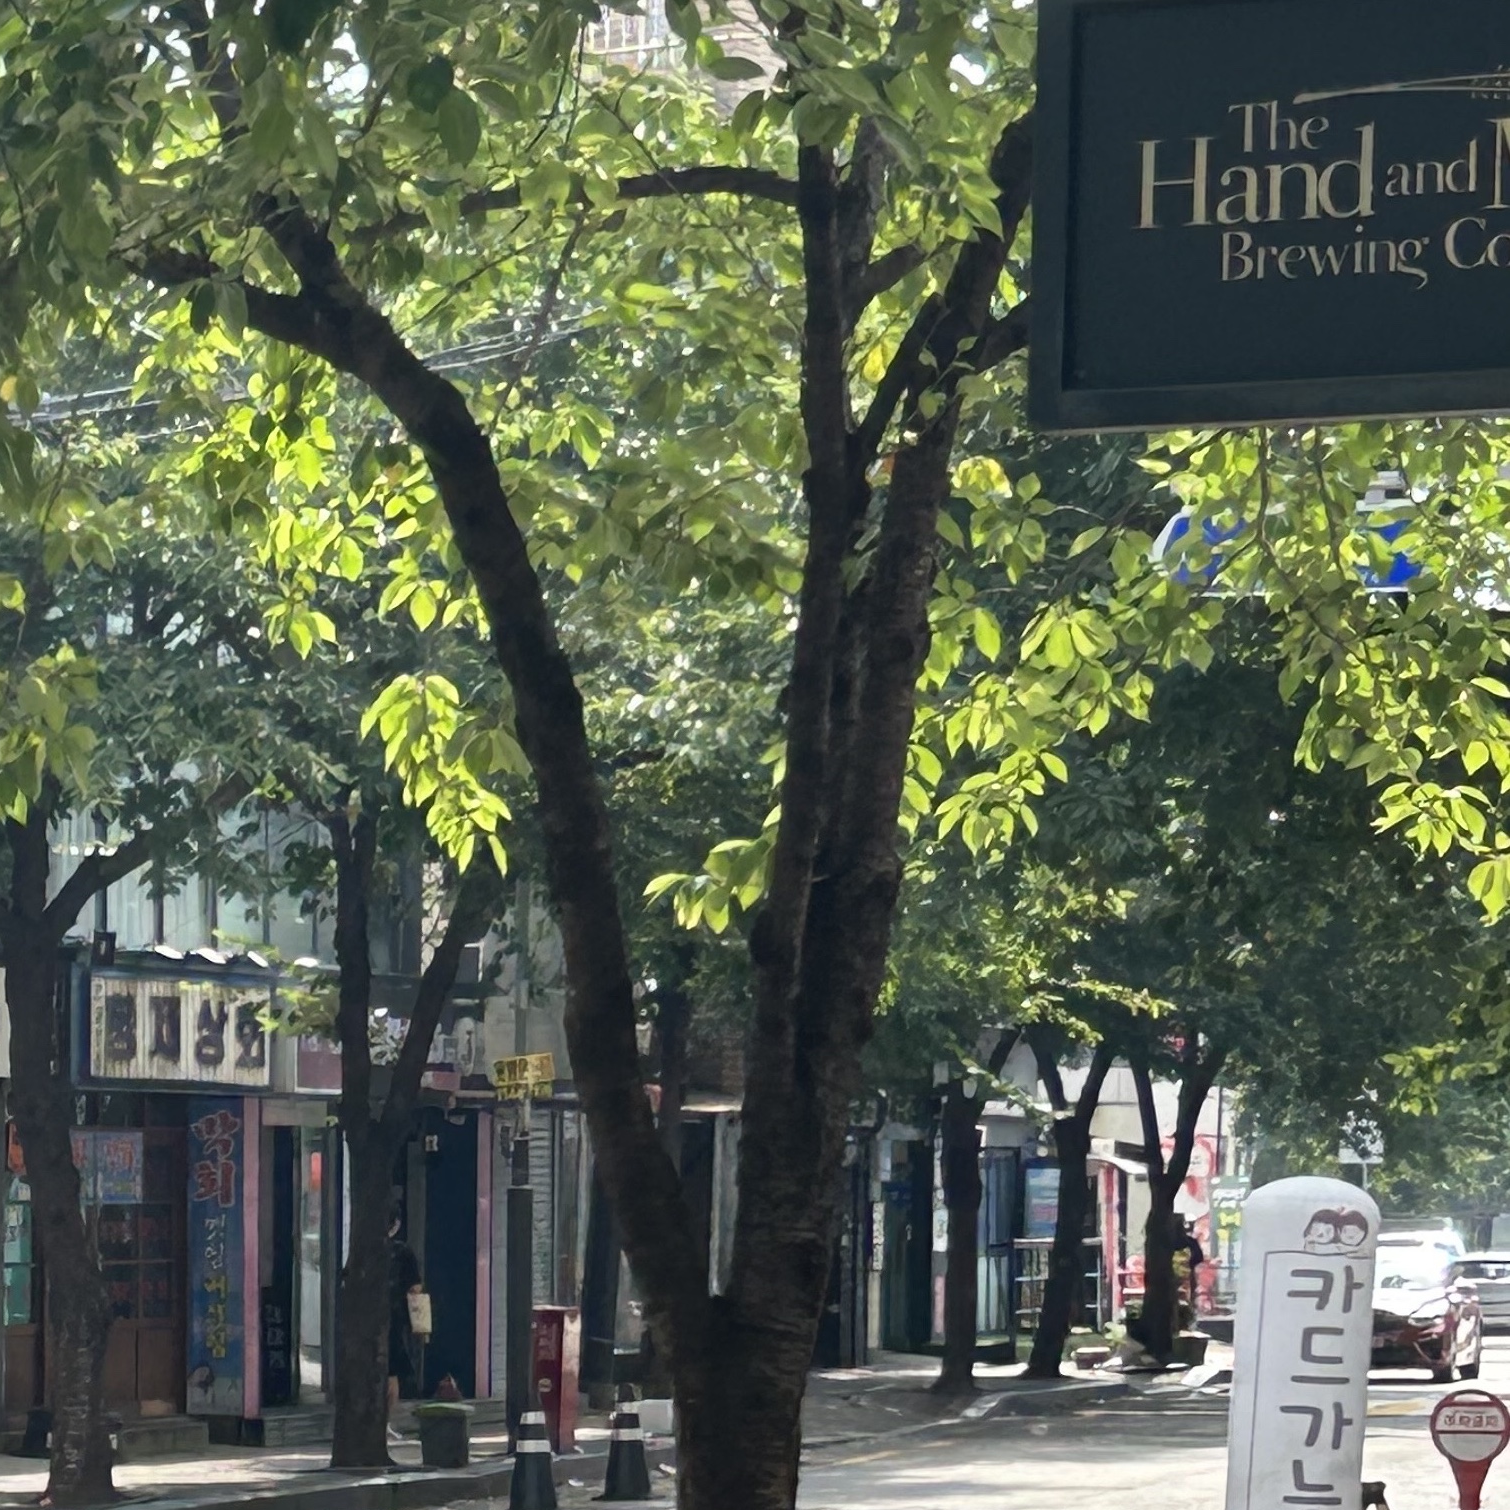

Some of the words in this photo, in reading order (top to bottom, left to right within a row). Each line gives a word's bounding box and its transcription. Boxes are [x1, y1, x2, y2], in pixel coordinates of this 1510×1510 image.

[1228, 100, 1329, 152] The
[1135, 120, 1376, 229] Hand
[1385, 138, 1478, 196] and
[1221, 225, 1430, 290] Brewing
